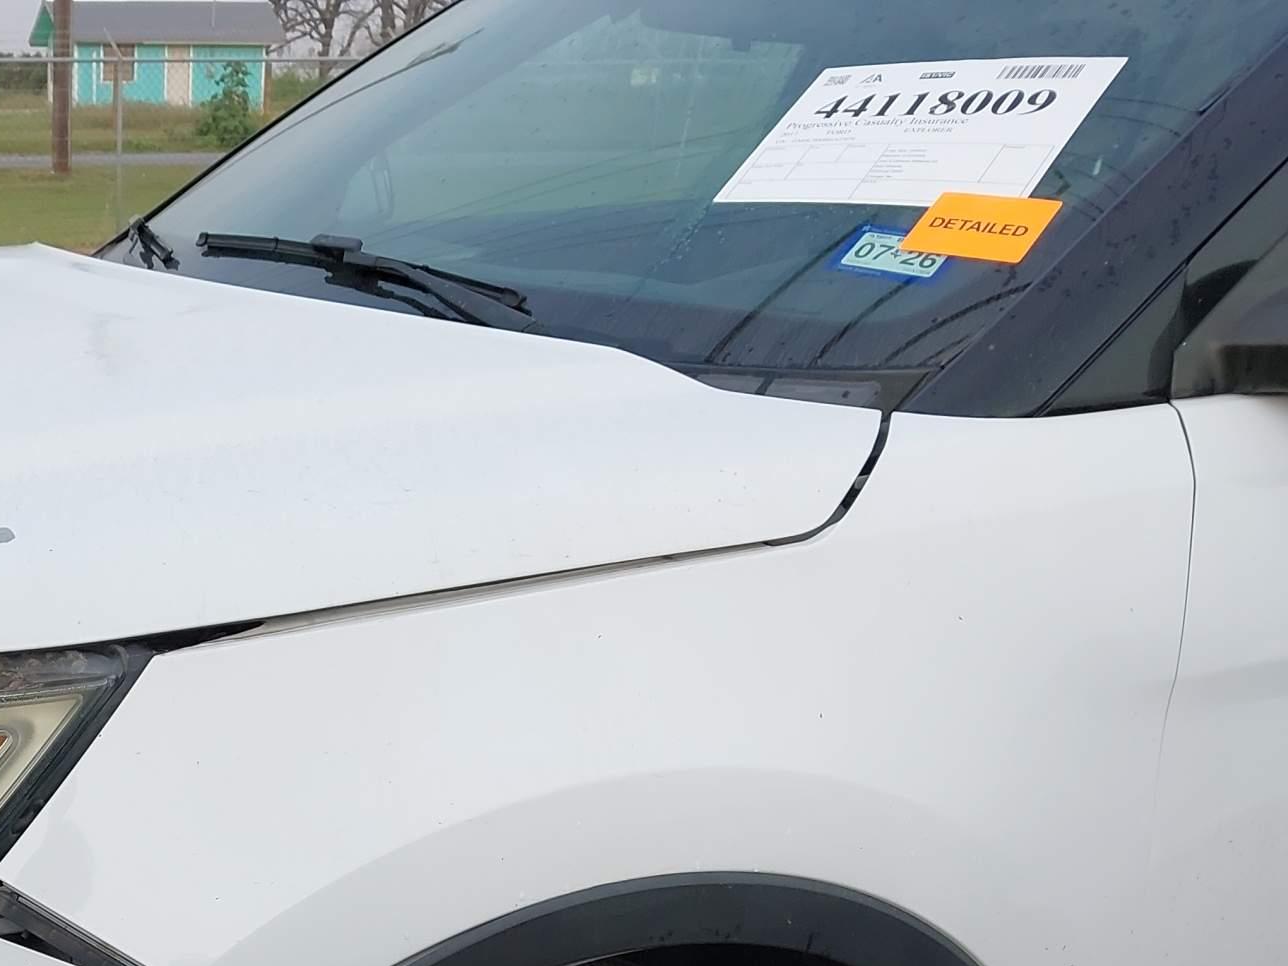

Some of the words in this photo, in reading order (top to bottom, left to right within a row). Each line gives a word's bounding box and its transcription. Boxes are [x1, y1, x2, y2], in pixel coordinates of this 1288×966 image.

[814, 88, 1057, 119] 44118009
[785, 119, 852, 131] Progressive
[855, 118, 904, 128] Casualty
[910, 117, 970, 126] Insurance
[929, 217, 1029, 237] DETAILED
[854, 242, 895, 260] 07
[899, 251, 940, 269] 26
